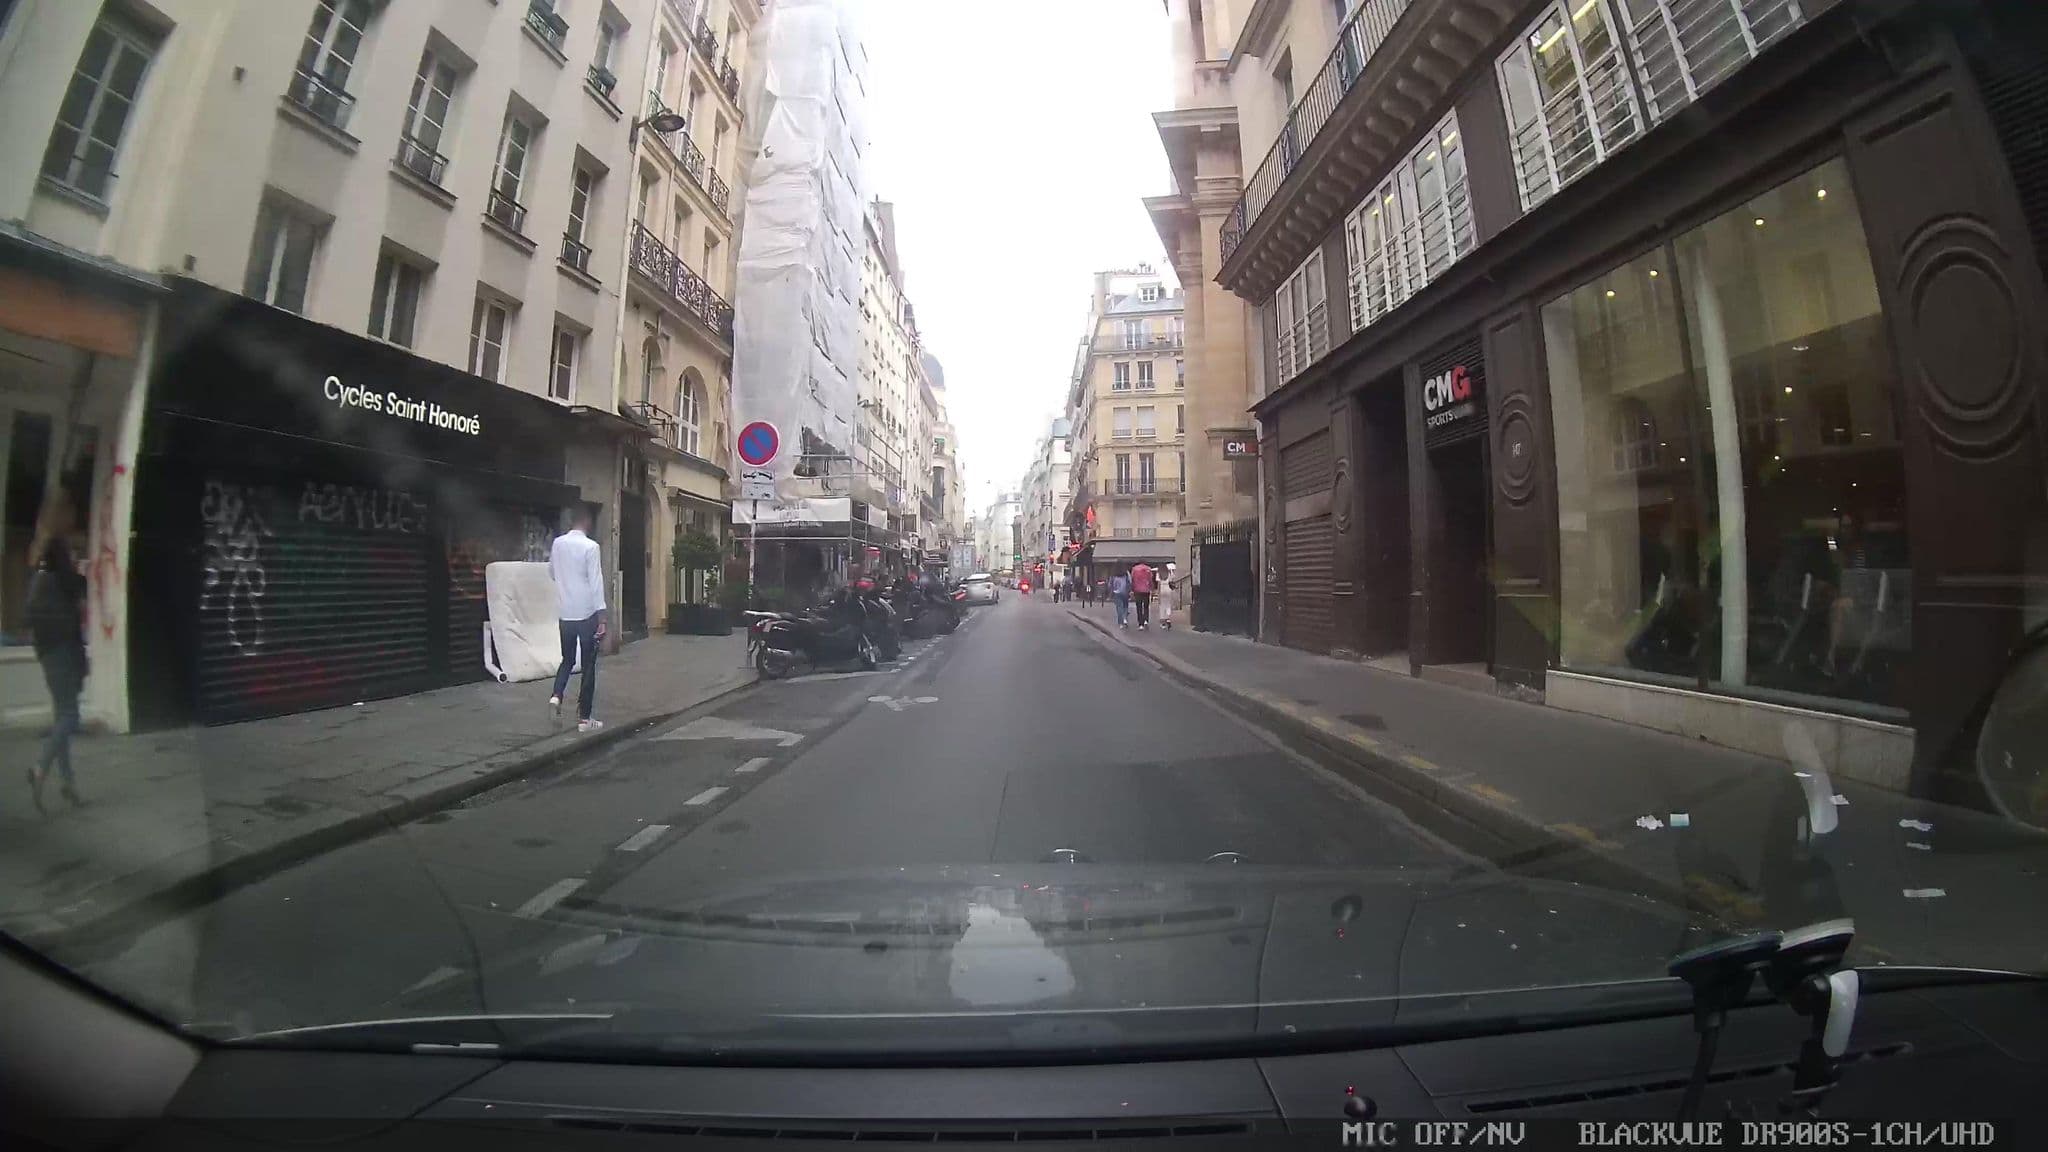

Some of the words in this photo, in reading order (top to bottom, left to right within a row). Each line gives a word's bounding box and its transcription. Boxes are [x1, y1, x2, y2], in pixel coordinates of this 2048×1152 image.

[324, 375, 383, 411] Cycles
[386, 391, 427, 422] Saint
[429, 403, 481, 435] Honoré
[1424, 365, 1472, 411] CMG
